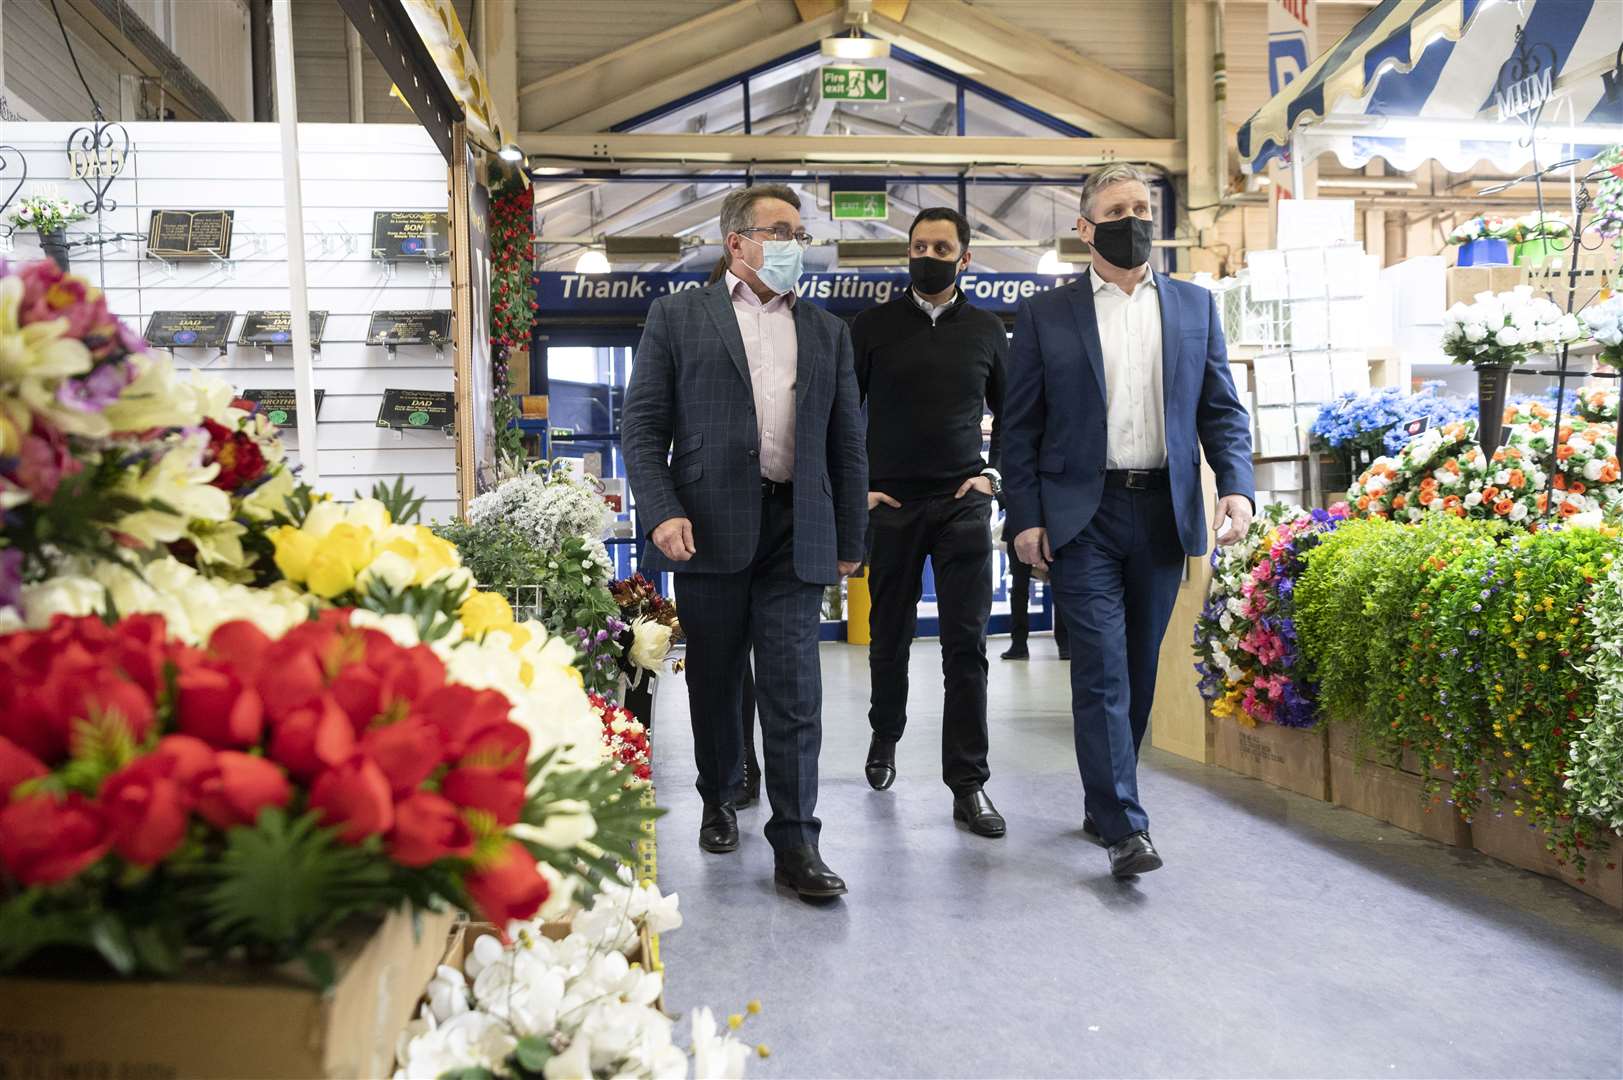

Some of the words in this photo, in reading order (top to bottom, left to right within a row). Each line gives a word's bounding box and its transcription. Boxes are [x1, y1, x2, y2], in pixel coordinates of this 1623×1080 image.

[824, 73, 846, 82] Fire
[824, 84, 846, 94] exit
[1495, 66, 1554, 122] MUM
[68, 149, 125, 180] DAD
[403, 224, 424, 232] SON
[560, 275, 645, 298] Thank
[959, 275, 1035, 302] Forge
[411, 399, 433, 407] DAD
